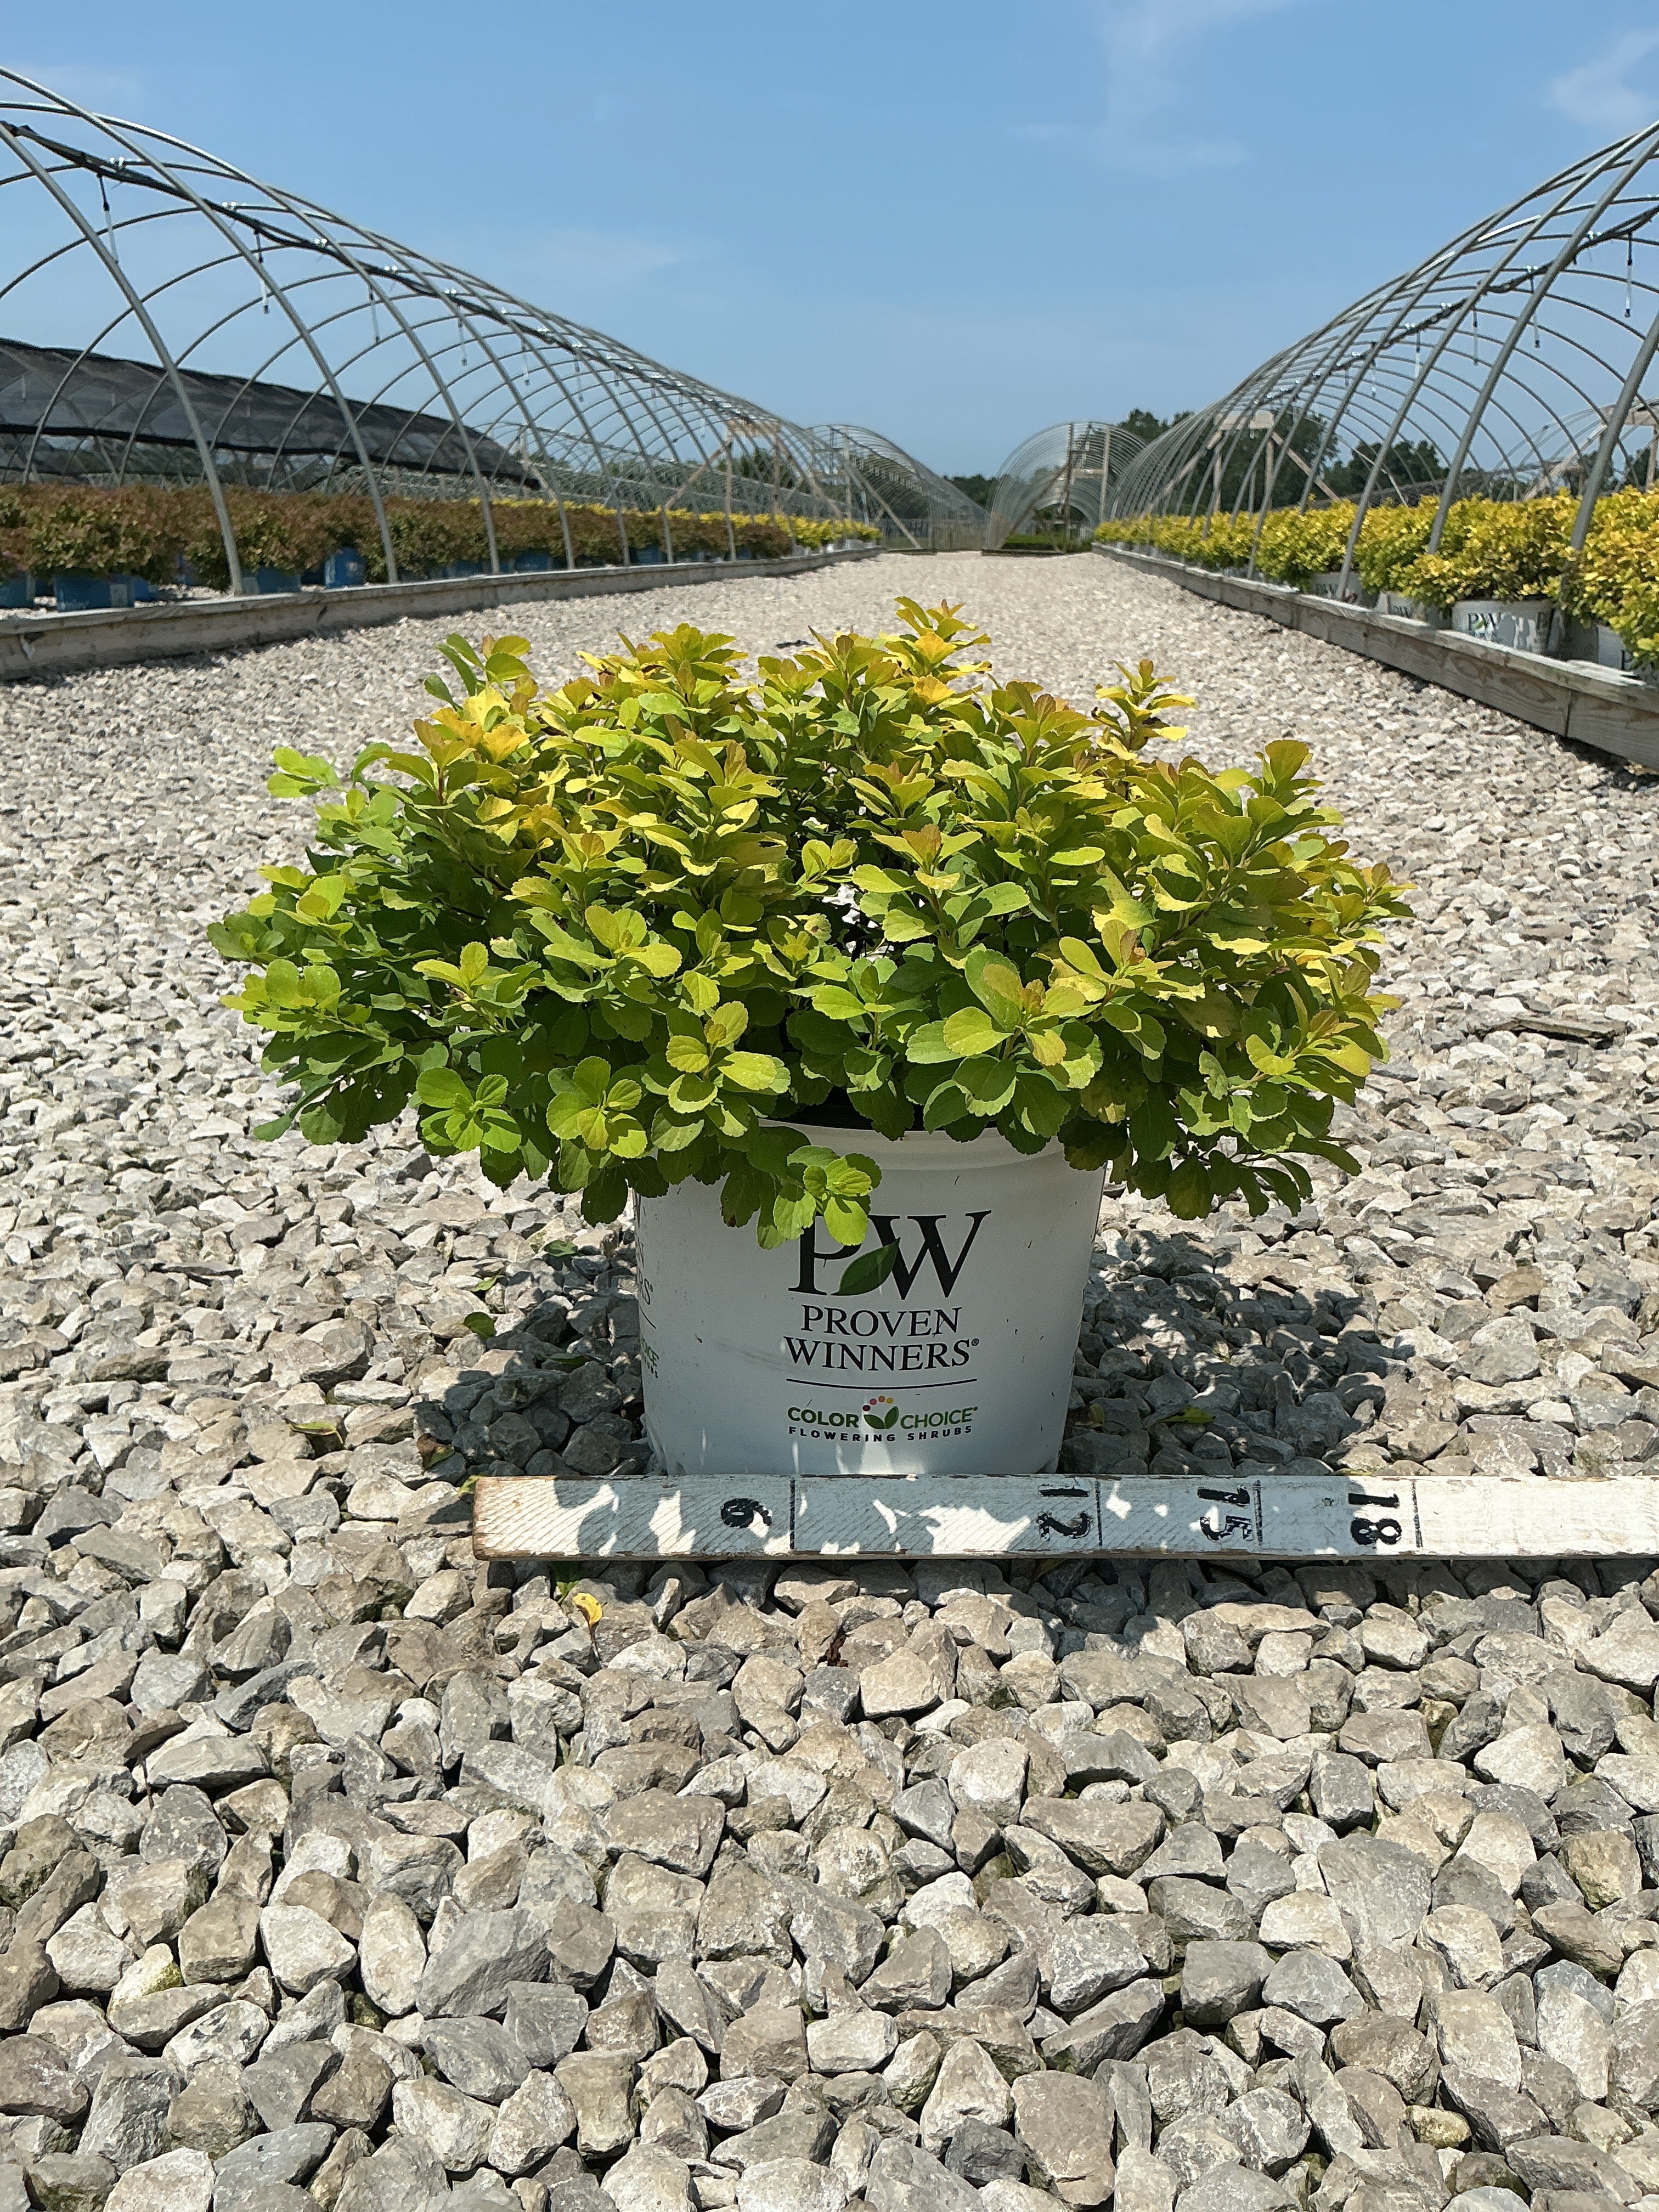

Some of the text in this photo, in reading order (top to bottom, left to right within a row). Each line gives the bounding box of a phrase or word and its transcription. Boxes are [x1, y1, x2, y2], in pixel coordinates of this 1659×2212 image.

[1468, 612, 1502, 632] PW
[788, 1210, 992, 1300] PW
[801, 1304, 962, 1337] PROVEN
[787, 1407, 859, 1428] COLOR
[789, 1425, 972, 1442] FLOWERING SHRUBS
[1348, 1492, 1402, 1545] 18
